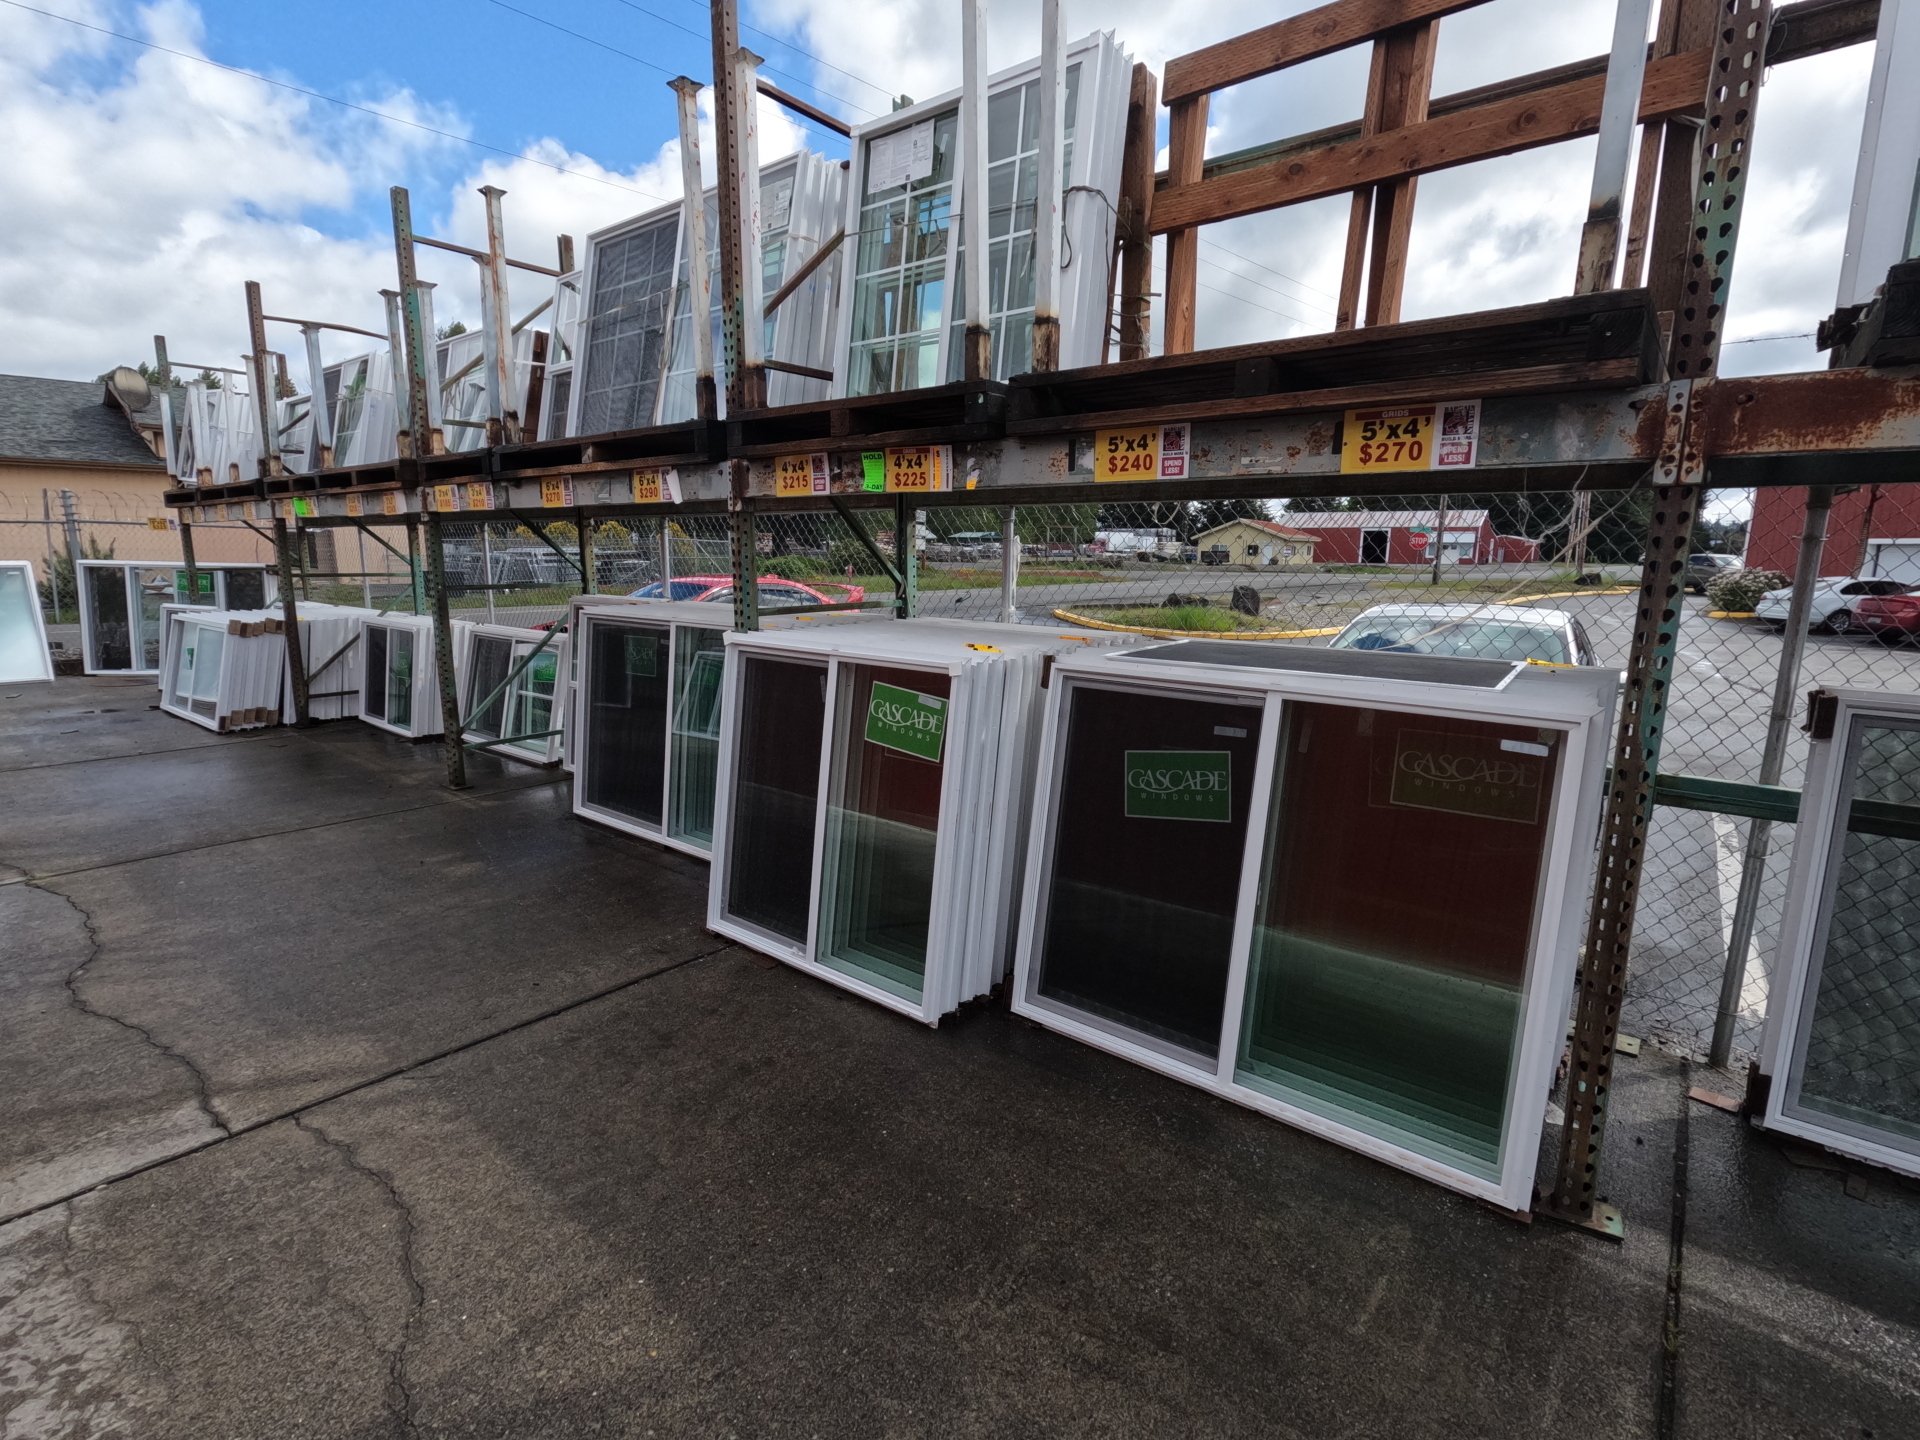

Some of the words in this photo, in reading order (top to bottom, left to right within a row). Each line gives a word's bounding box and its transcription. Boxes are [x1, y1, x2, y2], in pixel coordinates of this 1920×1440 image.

[1382, 409, 1409, 418] GRIDS
[1361, 416, 1431, 441] 5'x4'
[1108, 433, 1156, 453] 5'x4'
[1359, 441, 1423, 465] $270
[1444, 454, 1464, 462] LESS!
[782, 459, 808, 474] 4'x4'
[894, 454, 927, 469] 4'x4'
[1108, 453, 1153, 475] $240
[1164, 459, 1182, 467] SPEND
[783, 475, 808, 490] $215
[895, 472, 926, 488] $225
[640, 486, 658, 499] $290
[1411, 537, 1427, 545] STOP
[871, 699, 943, 734] CASCADE
[878, 721, 930, 741] WINDOWS
[1400, 750, 1537, 787] CASCADE
[1128, 769, 1227, 793] CASCADE
[1415, 778, 1515, 798] WINDOWS
[1141, 792, 1214, 801] WINDOWS
